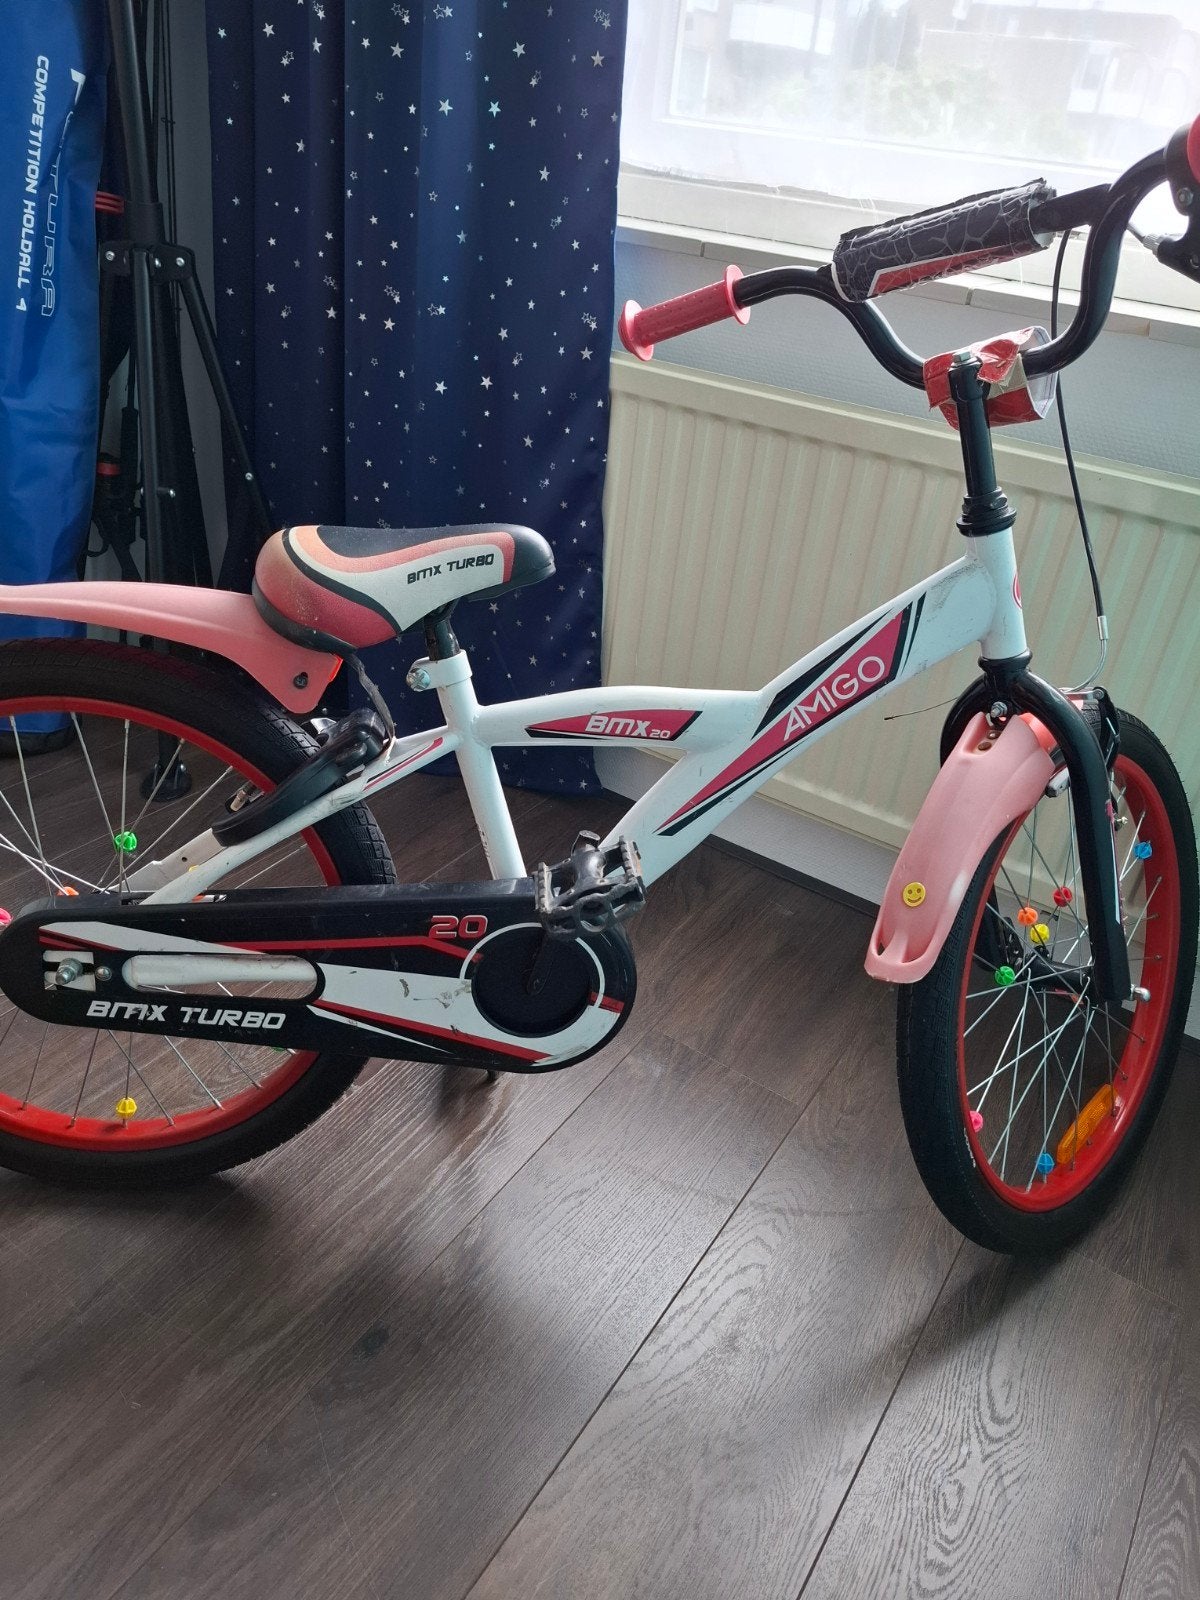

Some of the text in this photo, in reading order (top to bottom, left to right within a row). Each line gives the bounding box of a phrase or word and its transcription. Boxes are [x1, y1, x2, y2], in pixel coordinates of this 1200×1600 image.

[15, 55, 50, 312] COMPETITION HOLDALL 4
[40, 68, 86, 317] TURA
[407, 553, 495, 584] BMX TURBO
[783, 655, 885, 741] AMIGO
[585, 715, 671, 739] BMX 20
[428, 914, 488, 939] 20
[86, 1000, 287, 1030] BMX TURBO
